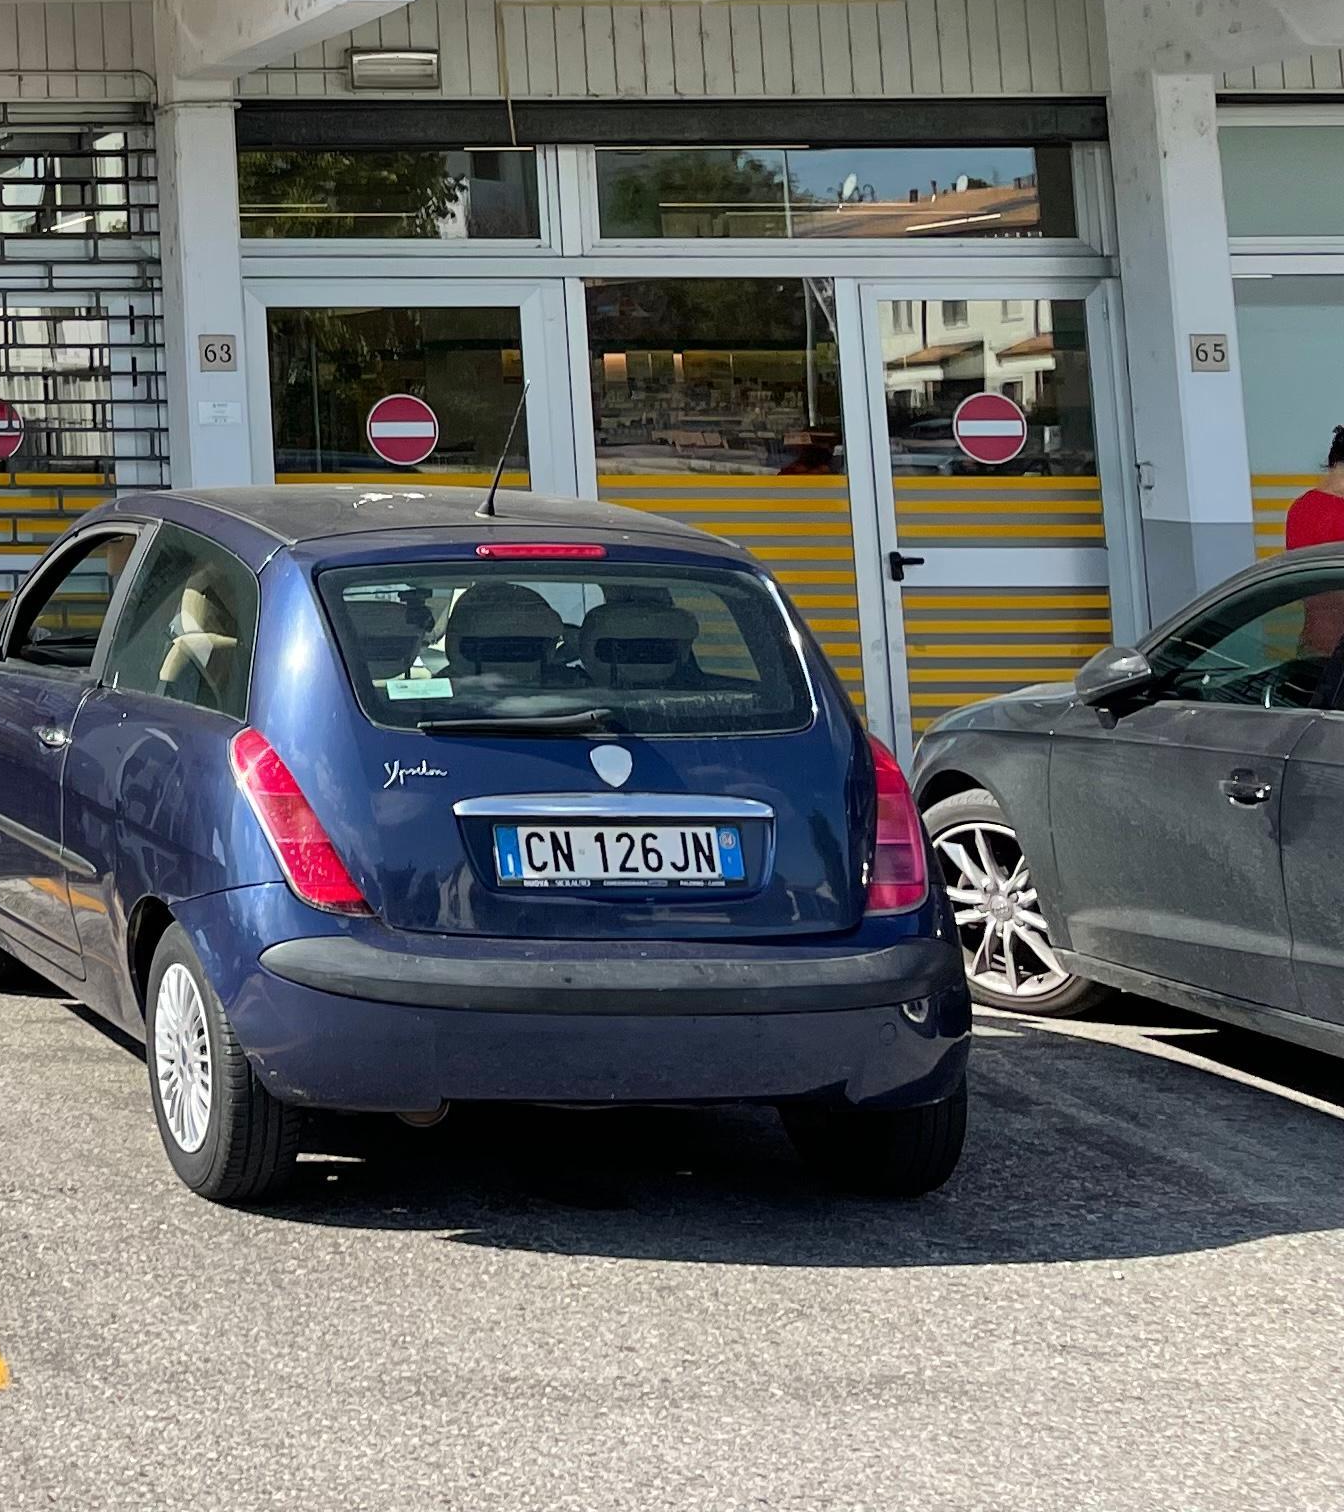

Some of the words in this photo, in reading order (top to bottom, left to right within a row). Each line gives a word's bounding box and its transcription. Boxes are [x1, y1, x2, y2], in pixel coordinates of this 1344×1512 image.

[204, 343, 232, 363] 63
[1195, 343, 1226, 363] 65
[525, 830, 576, 873] CN
[594, 831, 664, 874] 126
[670, 830, 717, 873] JN
